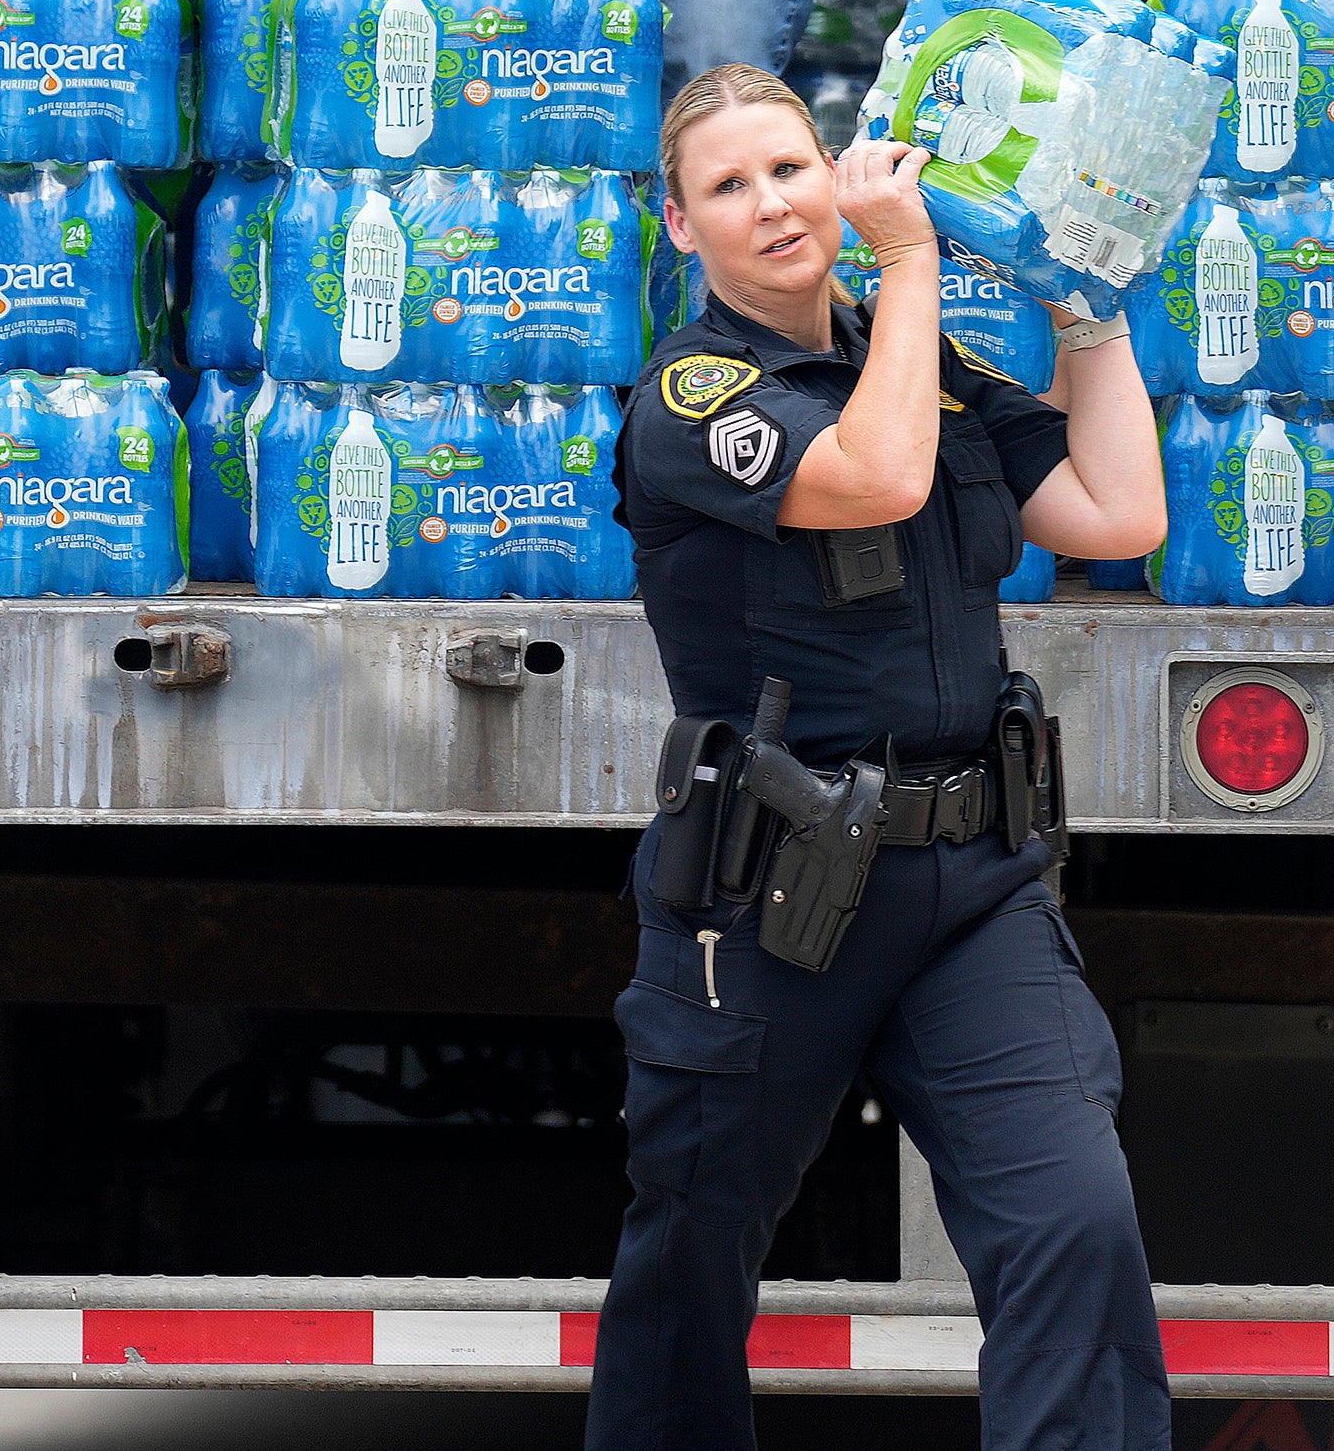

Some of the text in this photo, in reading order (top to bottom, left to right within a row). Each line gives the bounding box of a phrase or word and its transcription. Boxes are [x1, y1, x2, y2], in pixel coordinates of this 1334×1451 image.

[120, 6, 142, 23] 24
[383, 9, 408, 30] GIVE
[409, 12, 429, 34] THIS
[607, 10, 630, 27] 24
[1243, 25, 1269, 47] GIVE
[1270, 27, 1291, 47] THIS
[384, 33, 429, 63] BOTTLE
[383, 64, 427, 84] ANOTHER
[481, 44, 615, 101] niagara
[1244, 50, 1291, 80] BOTTLE
[1, 79, 135, 92] PURIFIED DRINKING WATER
[494, 87, 530, 98] PURIFIED
[553, 83, 599, 92] DRINKING
[601, 84, 626, 96] WATER
[1245, 82, 1289, 102] ANOTHER
[385, 87, 424, 128] LIFE
[1246, 104, 1289, 147] LIFE
[66, 224, 86, 242] 24
[351, 222, 399, 249] GIVE THIS
[582, 228, 606, 245] 24
[1200, 238, 1227, 260] GIVE
[1227, 239, 1250, 263] THIS
[351, 247, 398, 279] BOTTLE
[865, 273, 1002, 300] nara
[1202, 265, 1250, 292] BOTTLE
[351, 279, 396, 301] ANOTHER
[451, 262, 590, 322] niagara
[14, 296, 59, 307] DRINKING
[62, 297, 86, 308] WATER
[464, 304, 503, 316] PURIFIED
[528, 302, 573, 311] DRINKING
[575, 302, 601, 313] WATER
[1203, 294, 1249, 313] ANOTHER
[351, 302, 393, 343] LIFE
[942, 307, 1014, 321] DRINKING WATER
[1205, 315, 1249, 357] LIFE
[124, 438, 148, 454] 24
[335, 445, 360, 466] GIVE
[362, 446, 384, 467] THIS
[566, 443, 589, 459] 24
[123, 453, 149, 463] BOTTLES
[1250, 447, 1275, 471] GIVE
[1276, 451, 1297, 474] THIS
[336, 470, 383, 498] BOTTLE
[1252, 474, 1298, 503] BOTTLE
[7, 515, 45, 526] PURIFIED
[73, 512, 117, 524] DRINKING
[118, 515, 144, 526] WATER
[336, 500, 382, 521] ANOTHER
[437, 481, 576, 538] niagara
[1253, 505, 1296, 525] ANOTHER
[450, 524, 489, 534] PURIFIED
[514, 517, 560, 526] DRINKING
[562, 517, 588, 528] WATER
[336, 523, 381, 564] LIFE
[1253, 527, 1296, 572] LIFE
